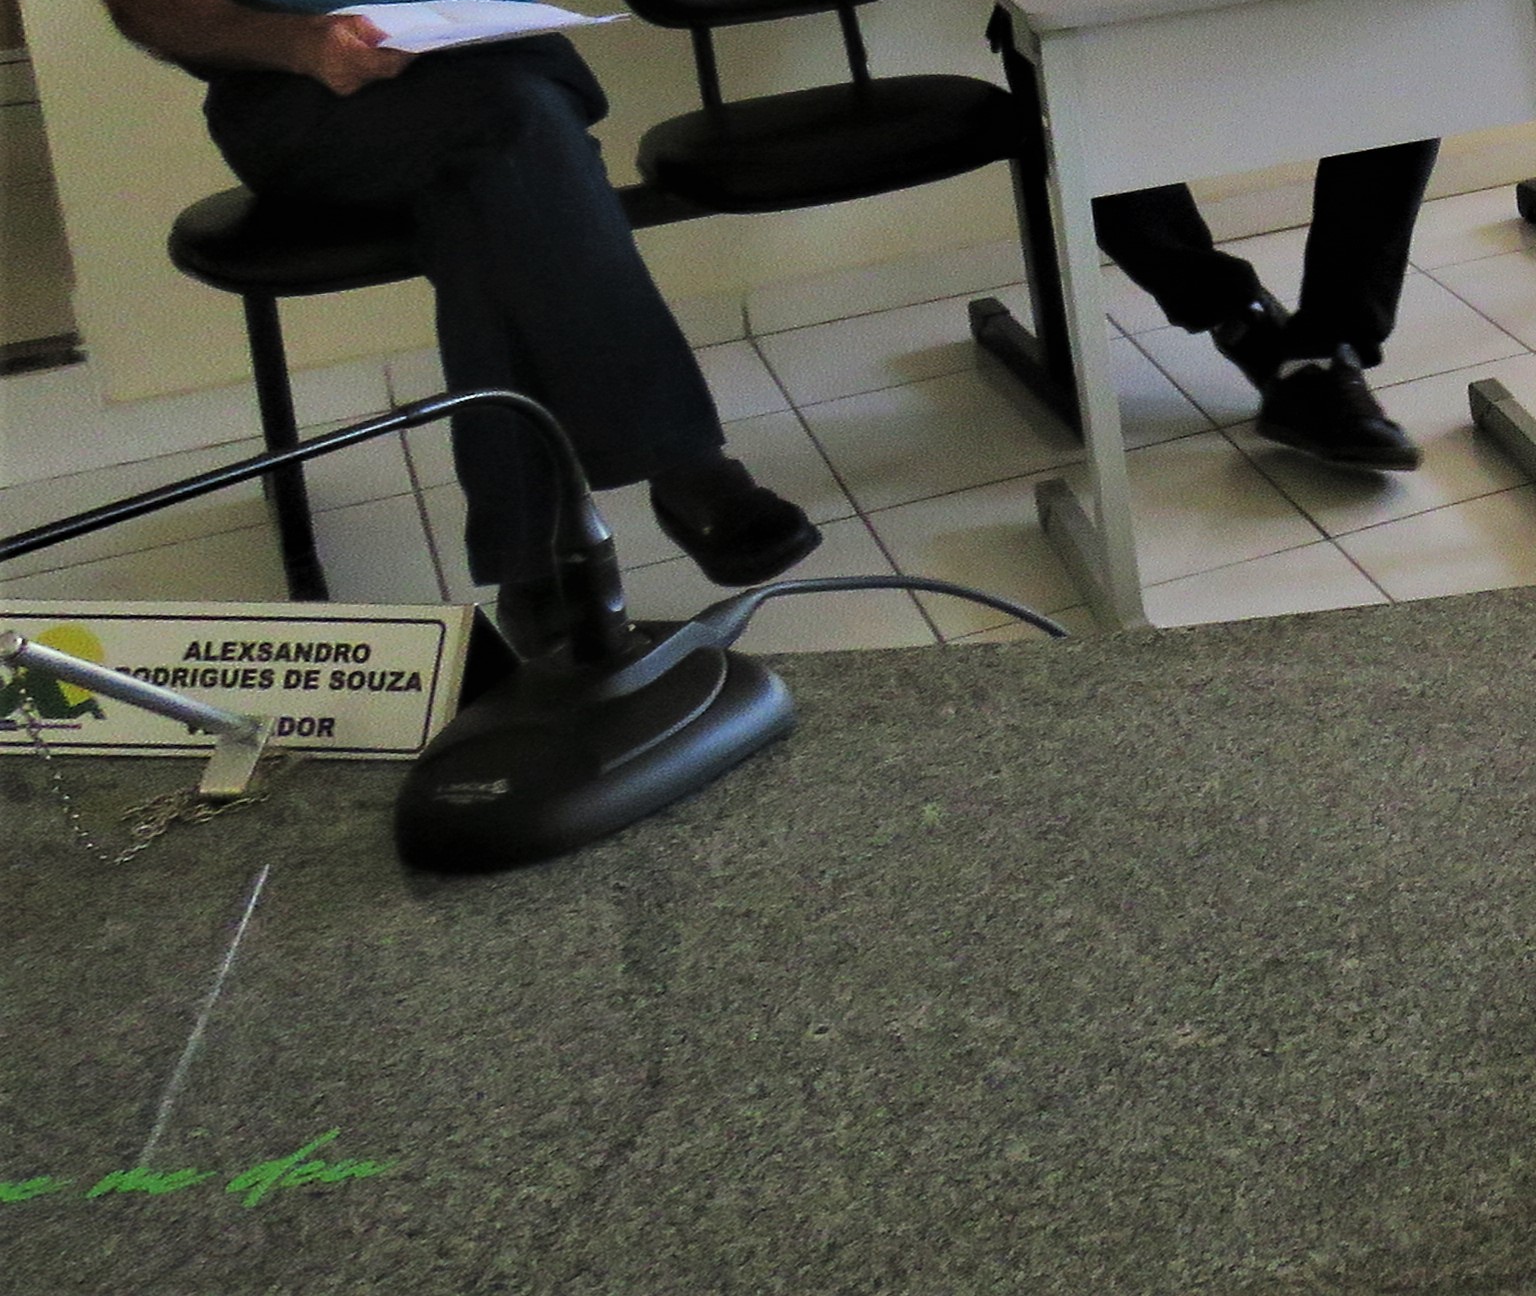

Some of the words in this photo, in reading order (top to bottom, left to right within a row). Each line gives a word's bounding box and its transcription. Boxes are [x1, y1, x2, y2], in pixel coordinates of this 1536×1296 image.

[183, 640, 372, 665] ALEXSANDRO
[283, 668, 321, 690] DE
[328, 669, 423, 693] SOUZA
